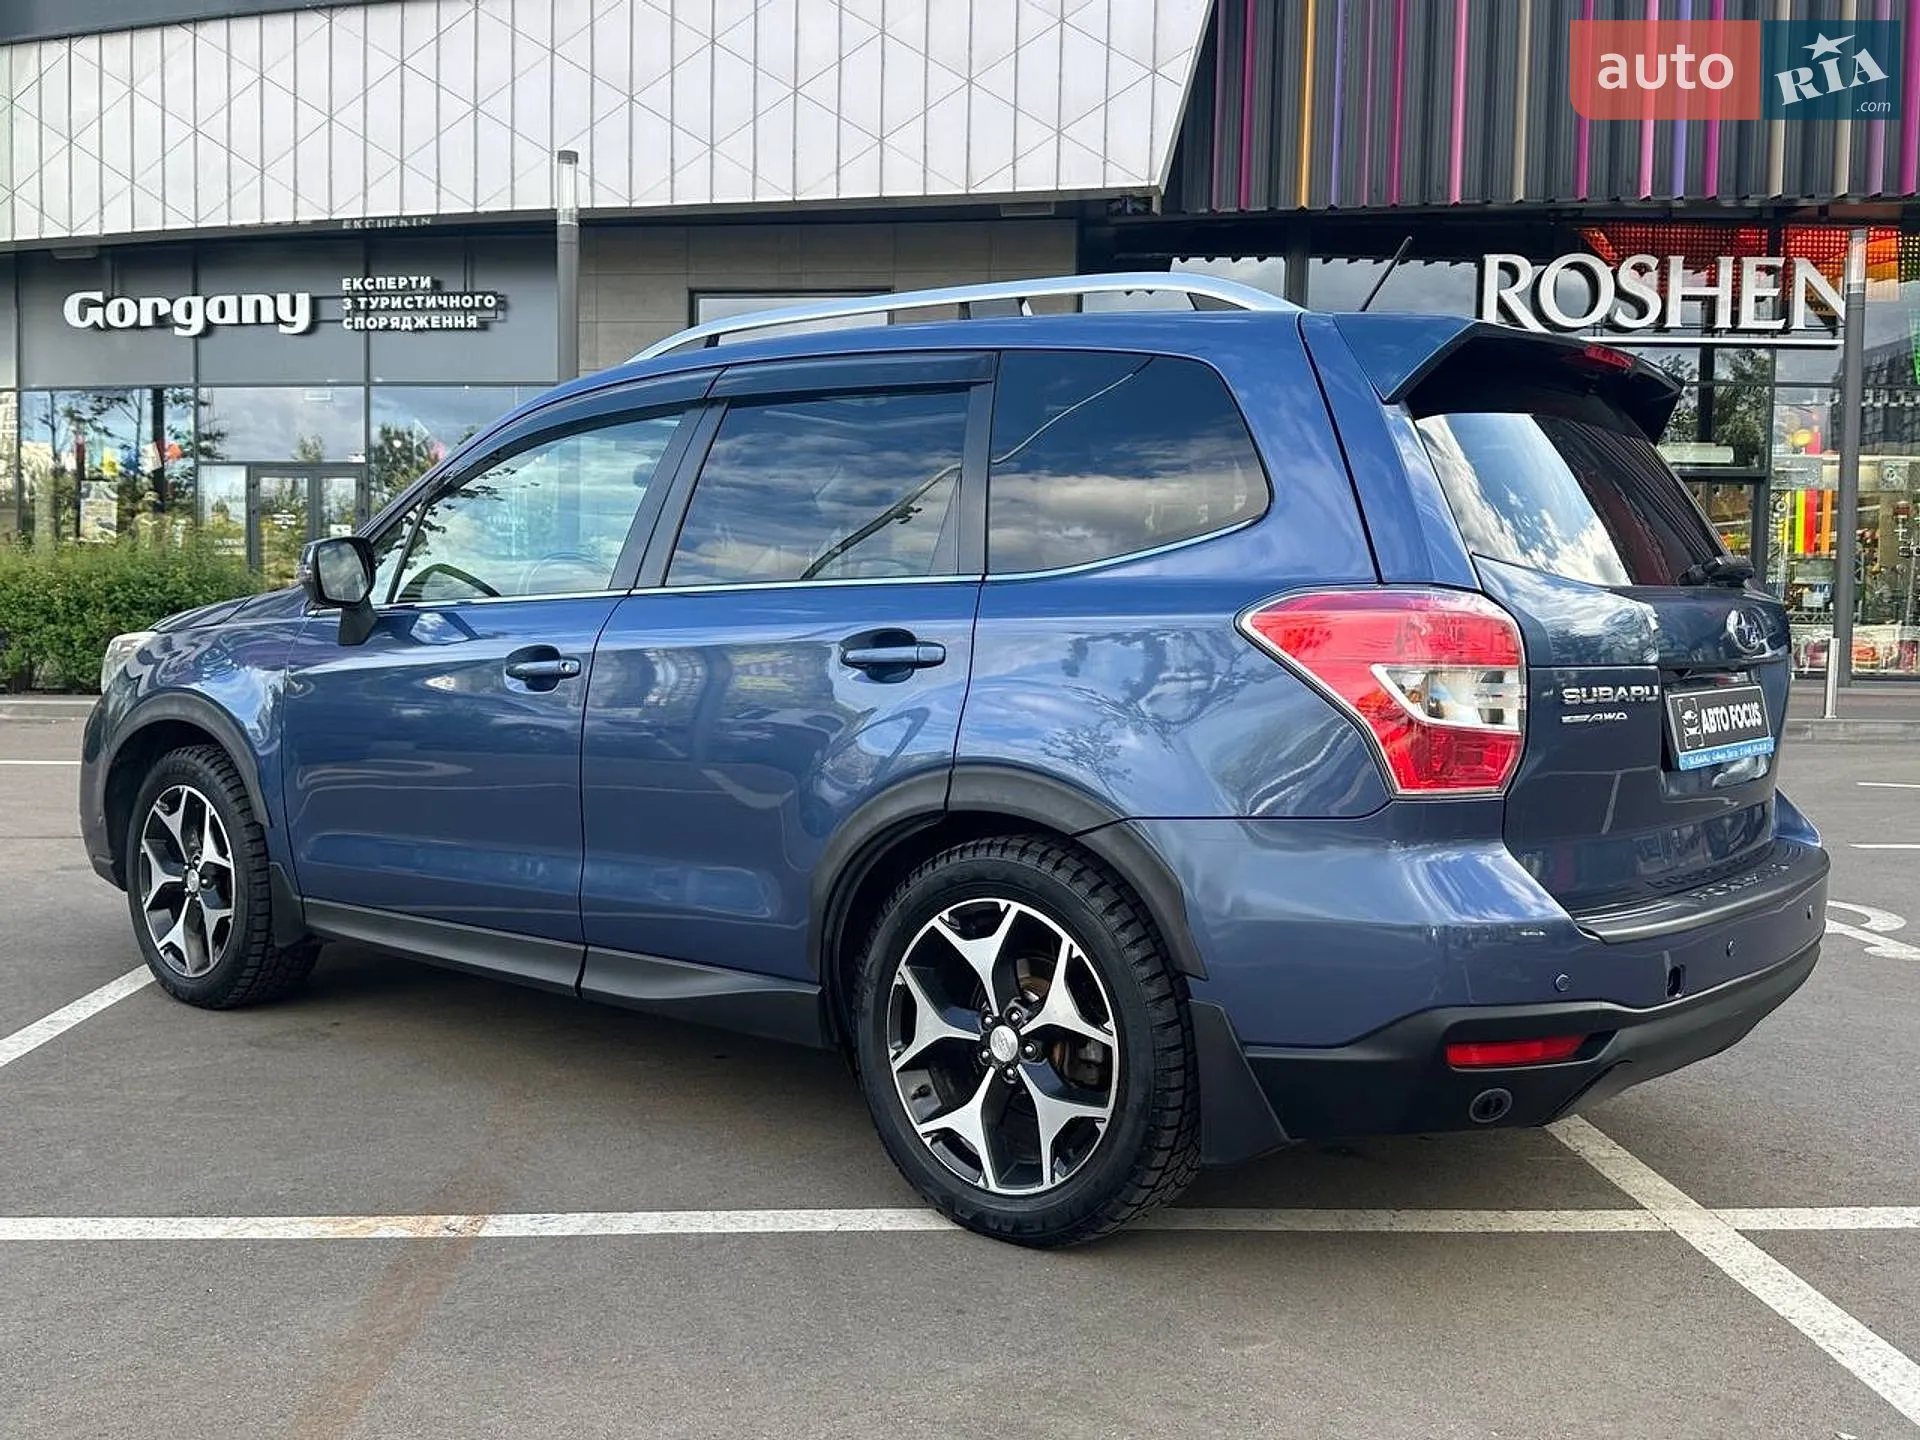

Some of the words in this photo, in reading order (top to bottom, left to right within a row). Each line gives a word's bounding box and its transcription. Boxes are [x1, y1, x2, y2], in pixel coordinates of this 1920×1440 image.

[342, 276, 432, 290] ЕКСПЕРТИ
[357, 295, 496, 309] ТУРИСТИЧНОГО
[1483, 253, 1847, 333] ROSHEN
[63, 291, 312, 335] Gorgany
[342, 316, 478, 330] СПОРЯДЖЕННЯ
[1562, 685, 1659, 704] SUBARU
[1728, 702, 1762, 730] FOCUS
